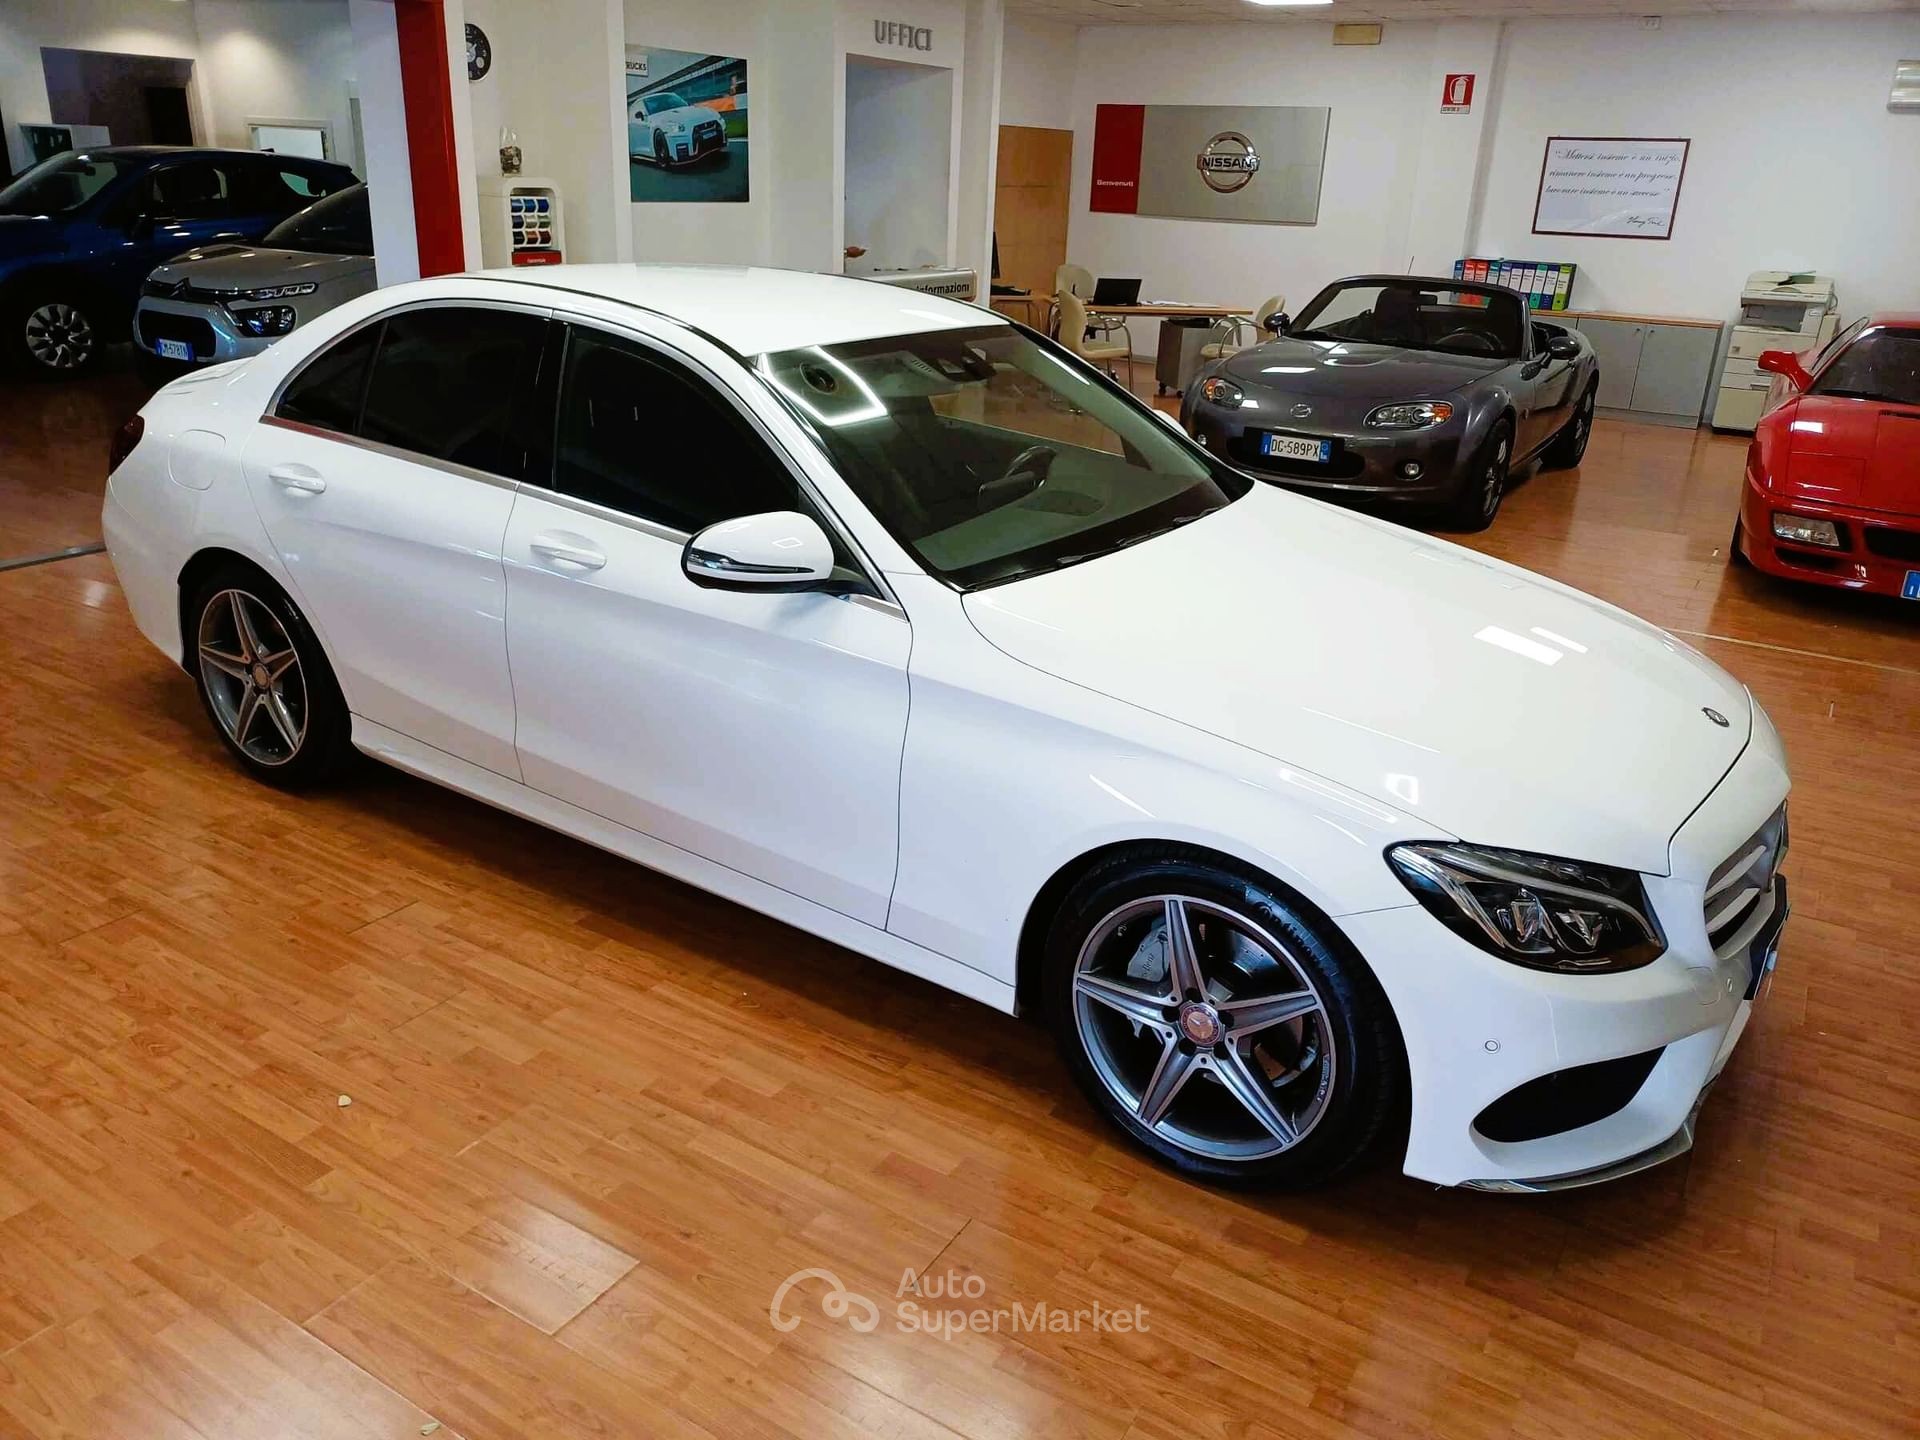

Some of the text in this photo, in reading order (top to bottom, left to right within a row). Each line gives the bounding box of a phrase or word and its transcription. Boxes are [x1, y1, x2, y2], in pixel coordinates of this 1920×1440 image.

[875, 19, 933, 51] UFFICI
[626, 61, 647, 71] RUCKS
[1202, 157, 1252, 169] NISSAN
[916, 282, 970, 295] formazioni
